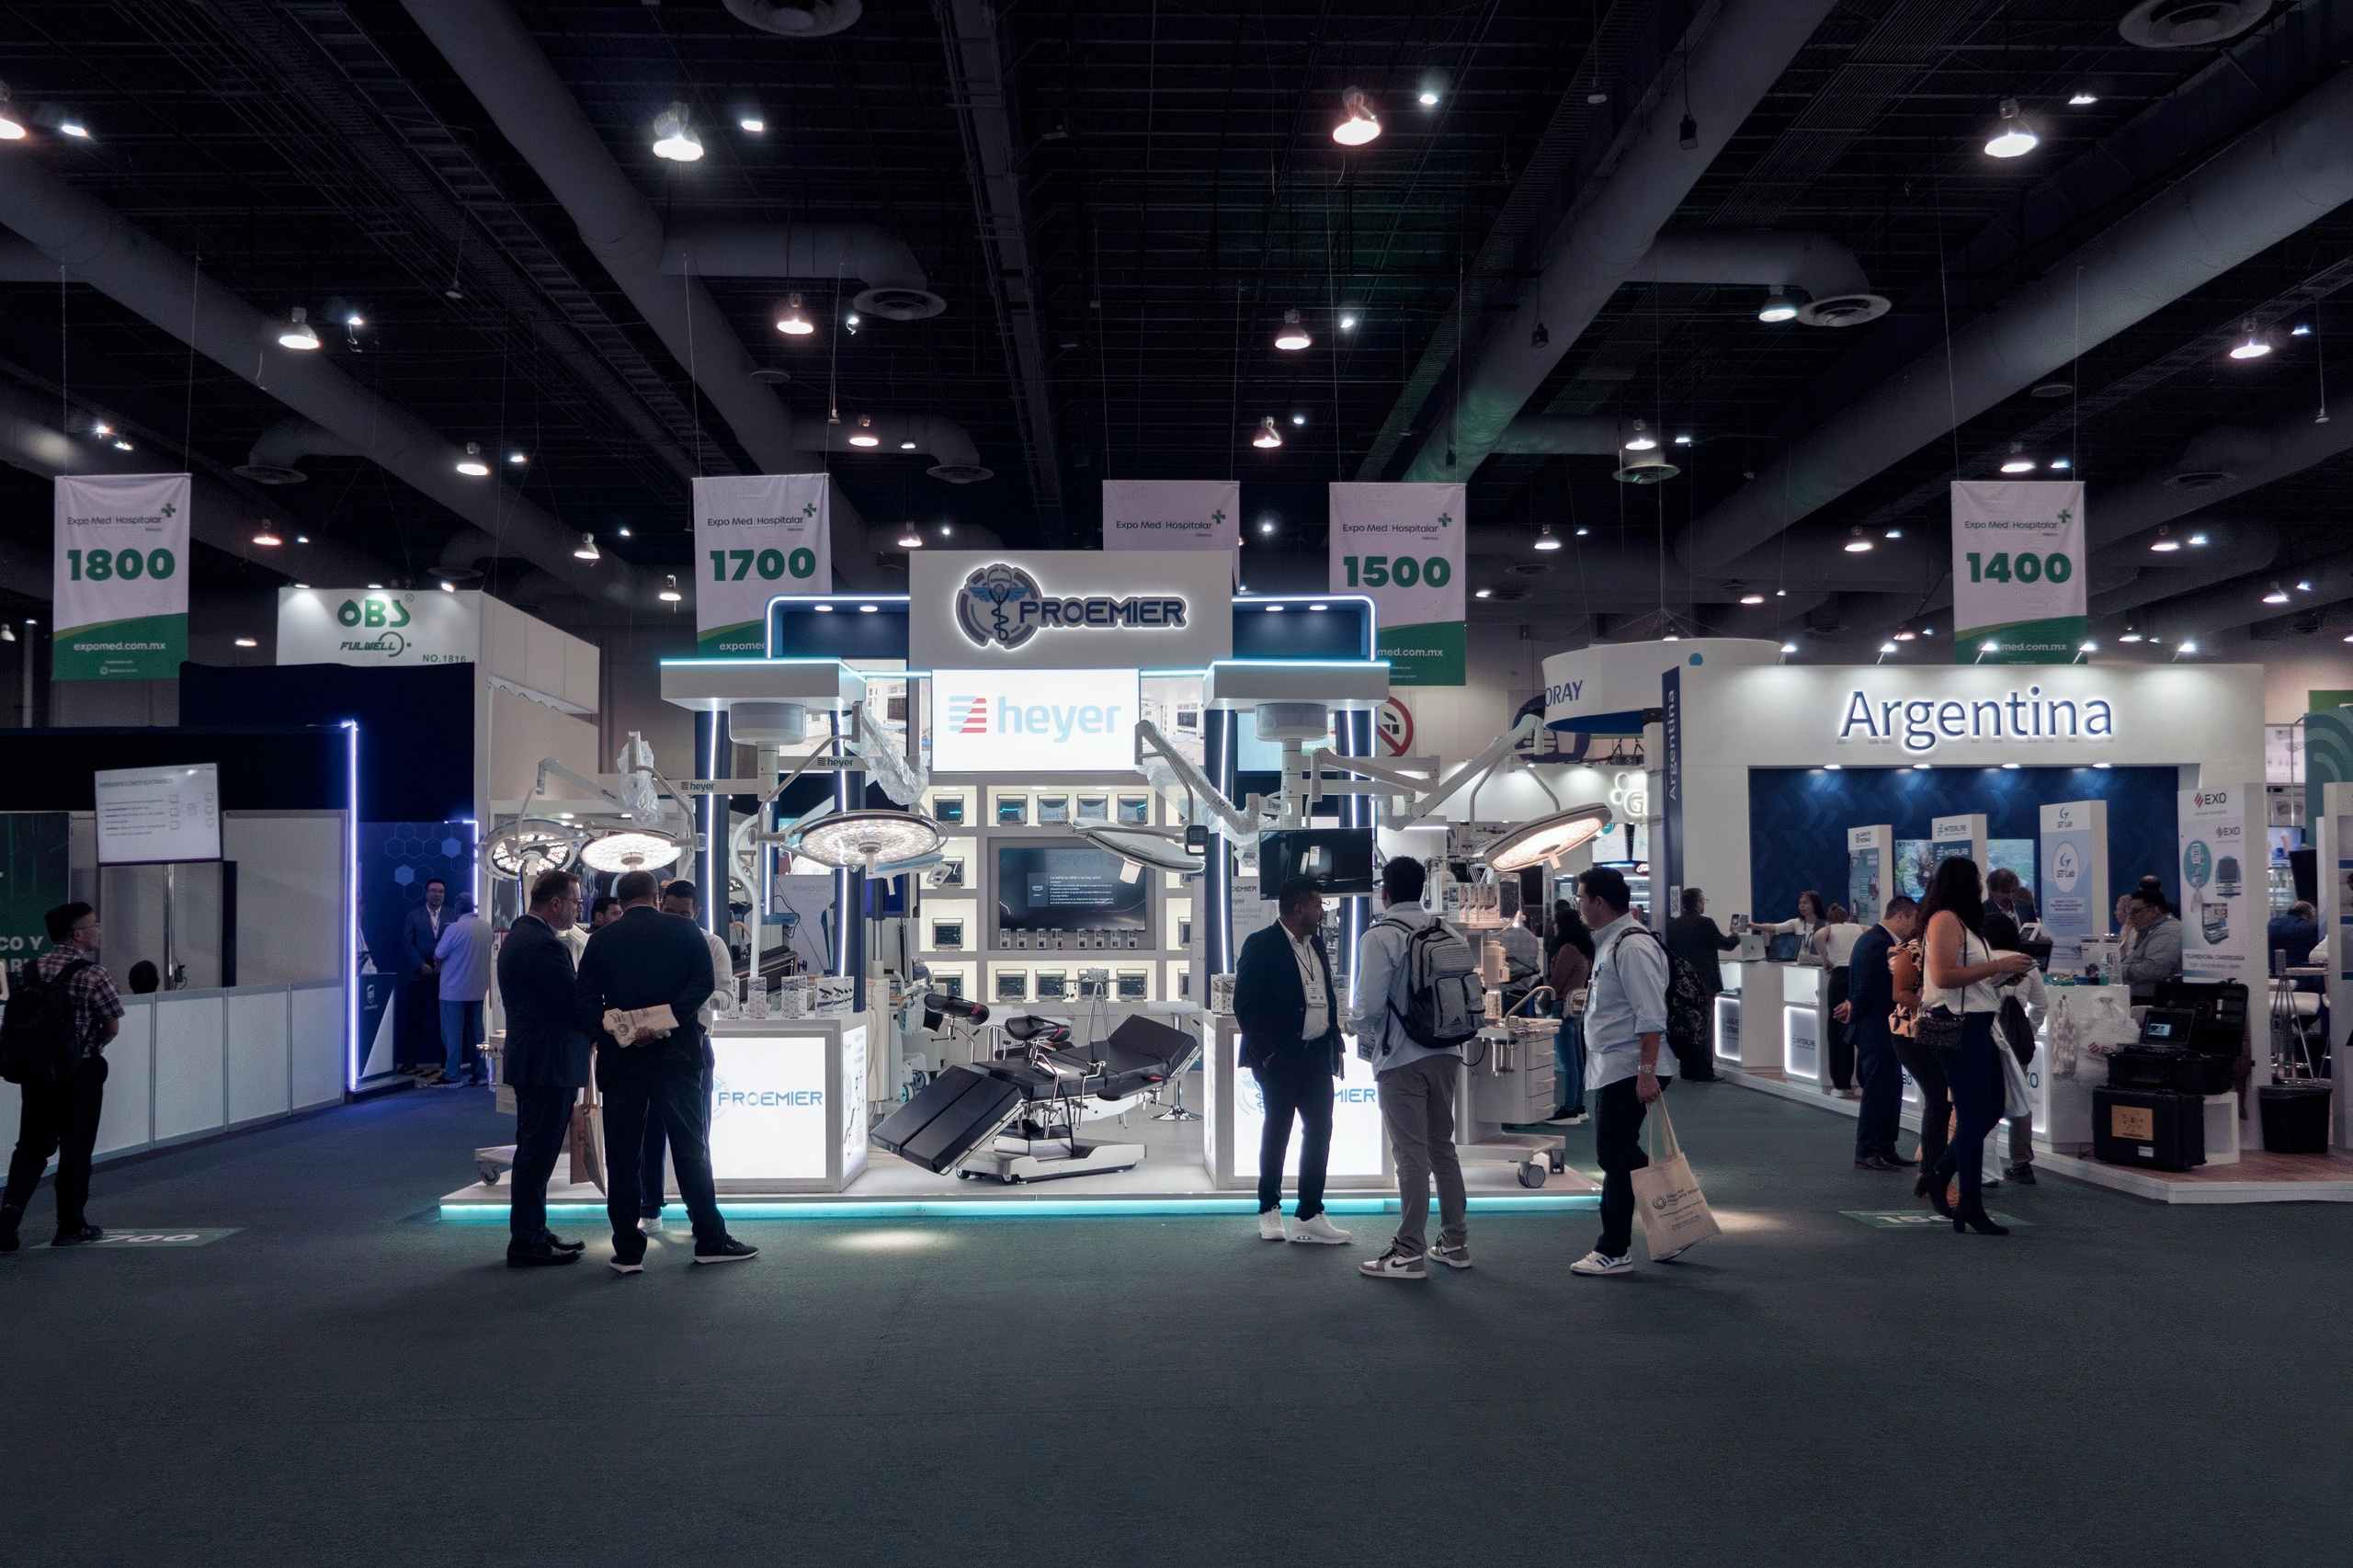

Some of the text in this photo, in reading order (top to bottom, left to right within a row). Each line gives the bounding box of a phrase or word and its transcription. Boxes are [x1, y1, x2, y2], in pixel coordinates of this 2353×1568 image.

[67, 516, 162, 527] Expo Med Hospitalar
[707, 516, 804, 528] Expo Med Hospitalar
[1116, 520, 1212, 530] Expo Med Hospitalar
[1964, 520, 2058, 530] Expo Med Hospitalar
[1342, 524, 1438, 534] Expo Med Hospitalar
[67, 548, 176, 582] 1800
[710, 547, 816, 582] 1700
[1966, 552, 2073, 584] 1400
[1343, 555, 1451, 588] 1500
[337, 598, 411, 628] OBS
[1019, 600, 1183, 624] PROEMIER
[74, 642, 166, 653] expomed.com.mx
[340, 642, 396, 651] FULWELL
[1377, 648, 1444, 657] med.com.mx
[422, 653, 467, 664] NO.1816
[997, 696, 1121, 744] heyer
[1839, 686, 2112, 751] Argentina
[1667, 689, 1678, 801] Argentina
[827, 757, 854, 768] heyer
[689, 781, 714, 792] heyer
[2204, 792, 2227, 805] EXO
[2223, 826, 2240, 835] EXO
[2056, 869, 2075, 878] GT Lab
[718, 1091, 824, 1107] PROEMIER
[1334, 1088, 1376, 1103] MIER
[94, 1234, 199, 1244] 700
